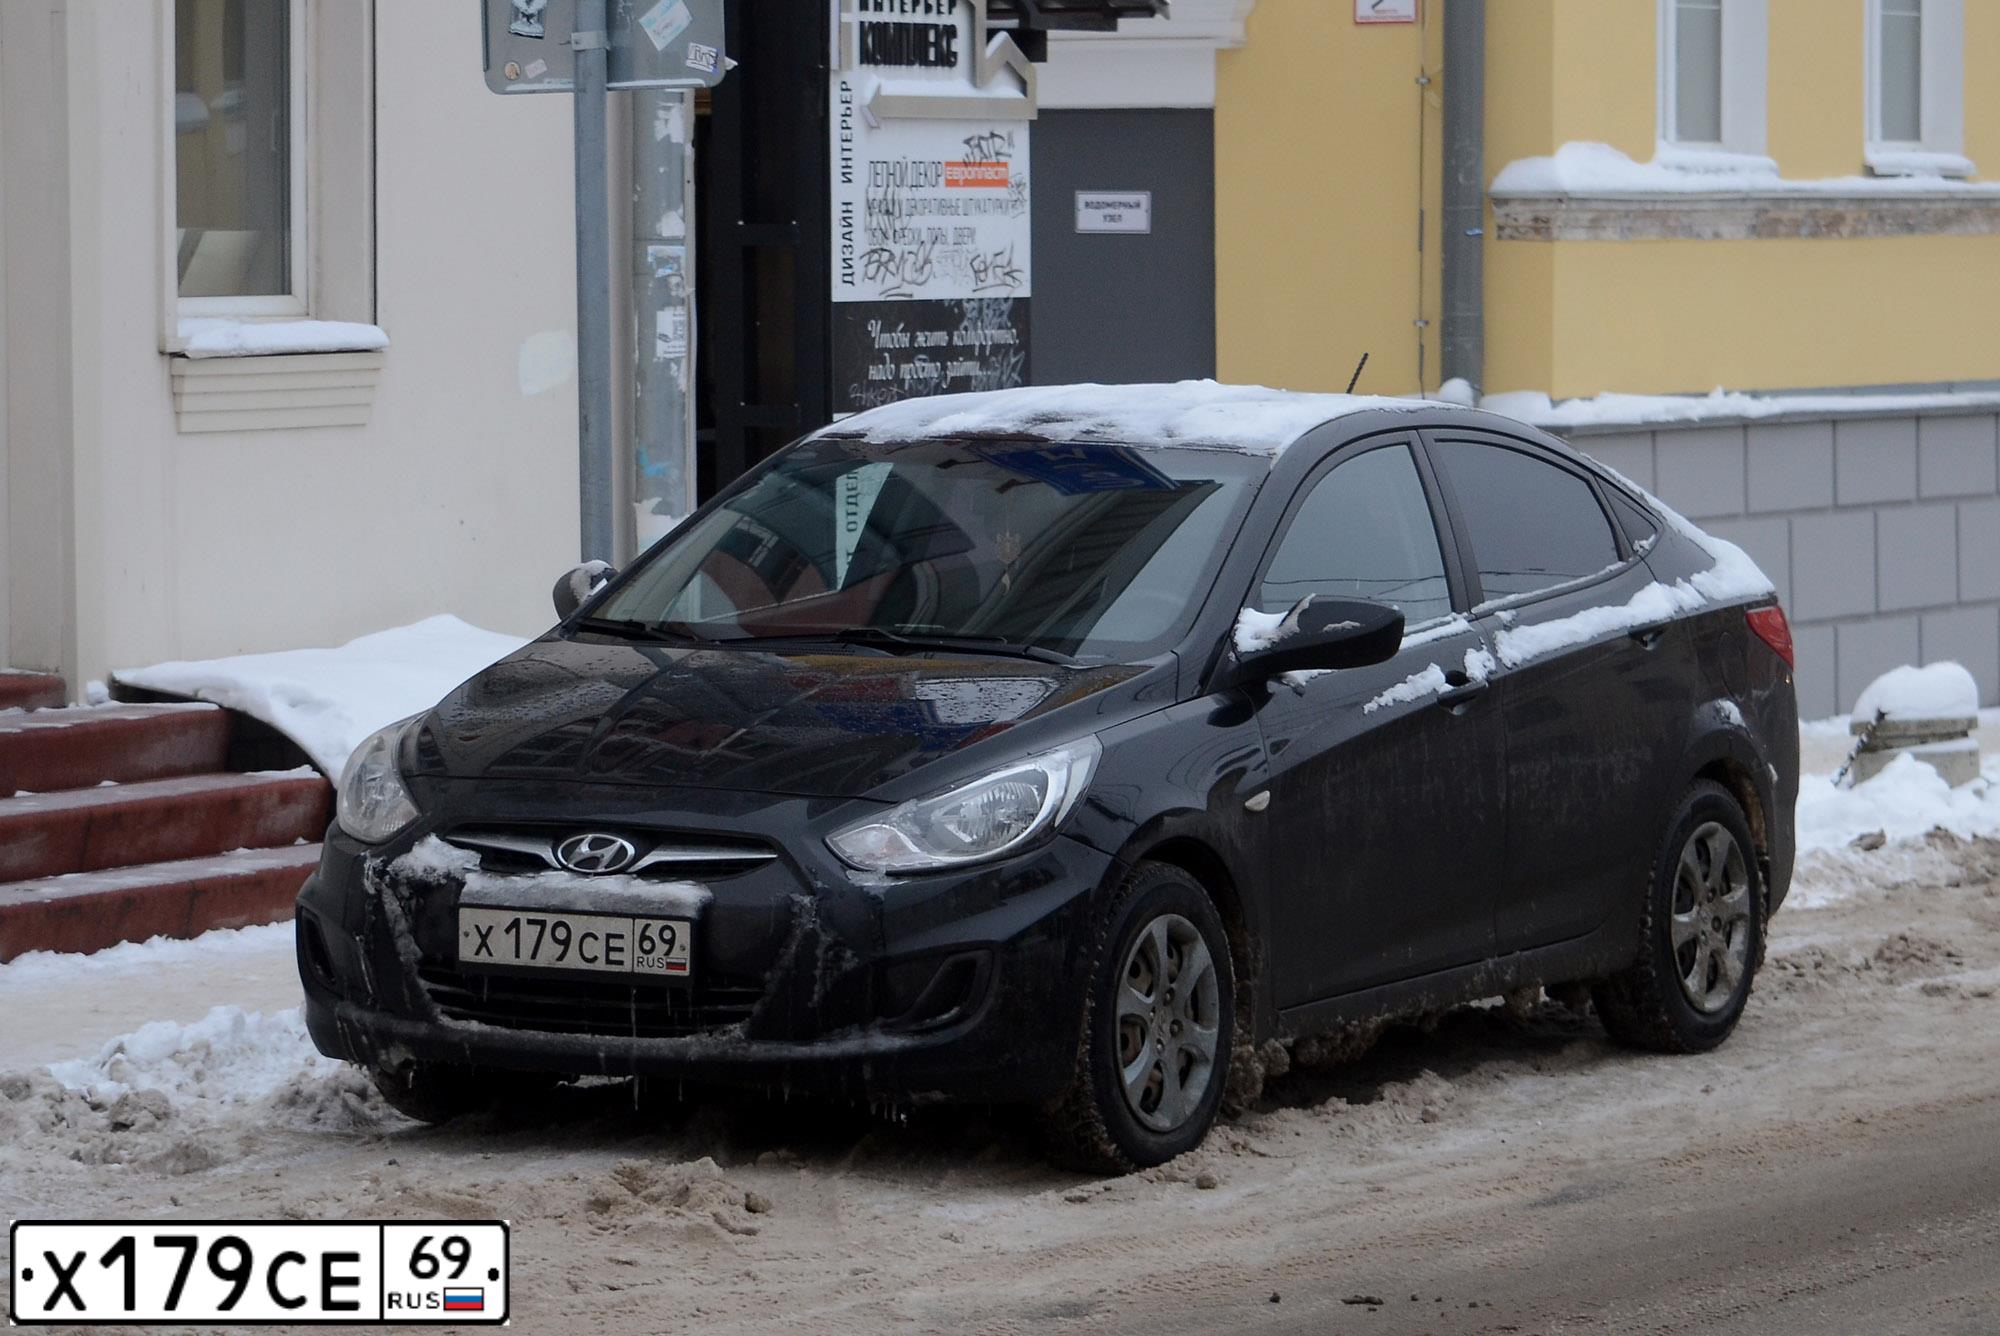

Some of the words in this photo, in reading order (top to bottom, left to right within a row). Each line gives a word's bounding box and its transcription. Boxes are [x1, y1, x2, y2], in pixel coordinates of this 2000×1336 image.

[859, 21, 958, 67] КОМПЛЕКС
[840, 81, 853, 183] ИНТЕРЬЕР
[910, 161, 943, 191] ДЕКОР
[839, 202, 855, 286] ДИЗАЙН
[868, 352, 896, 381] надо
[638, 922, 677, 957] 69
[636, 956, 665, 969] RUS
